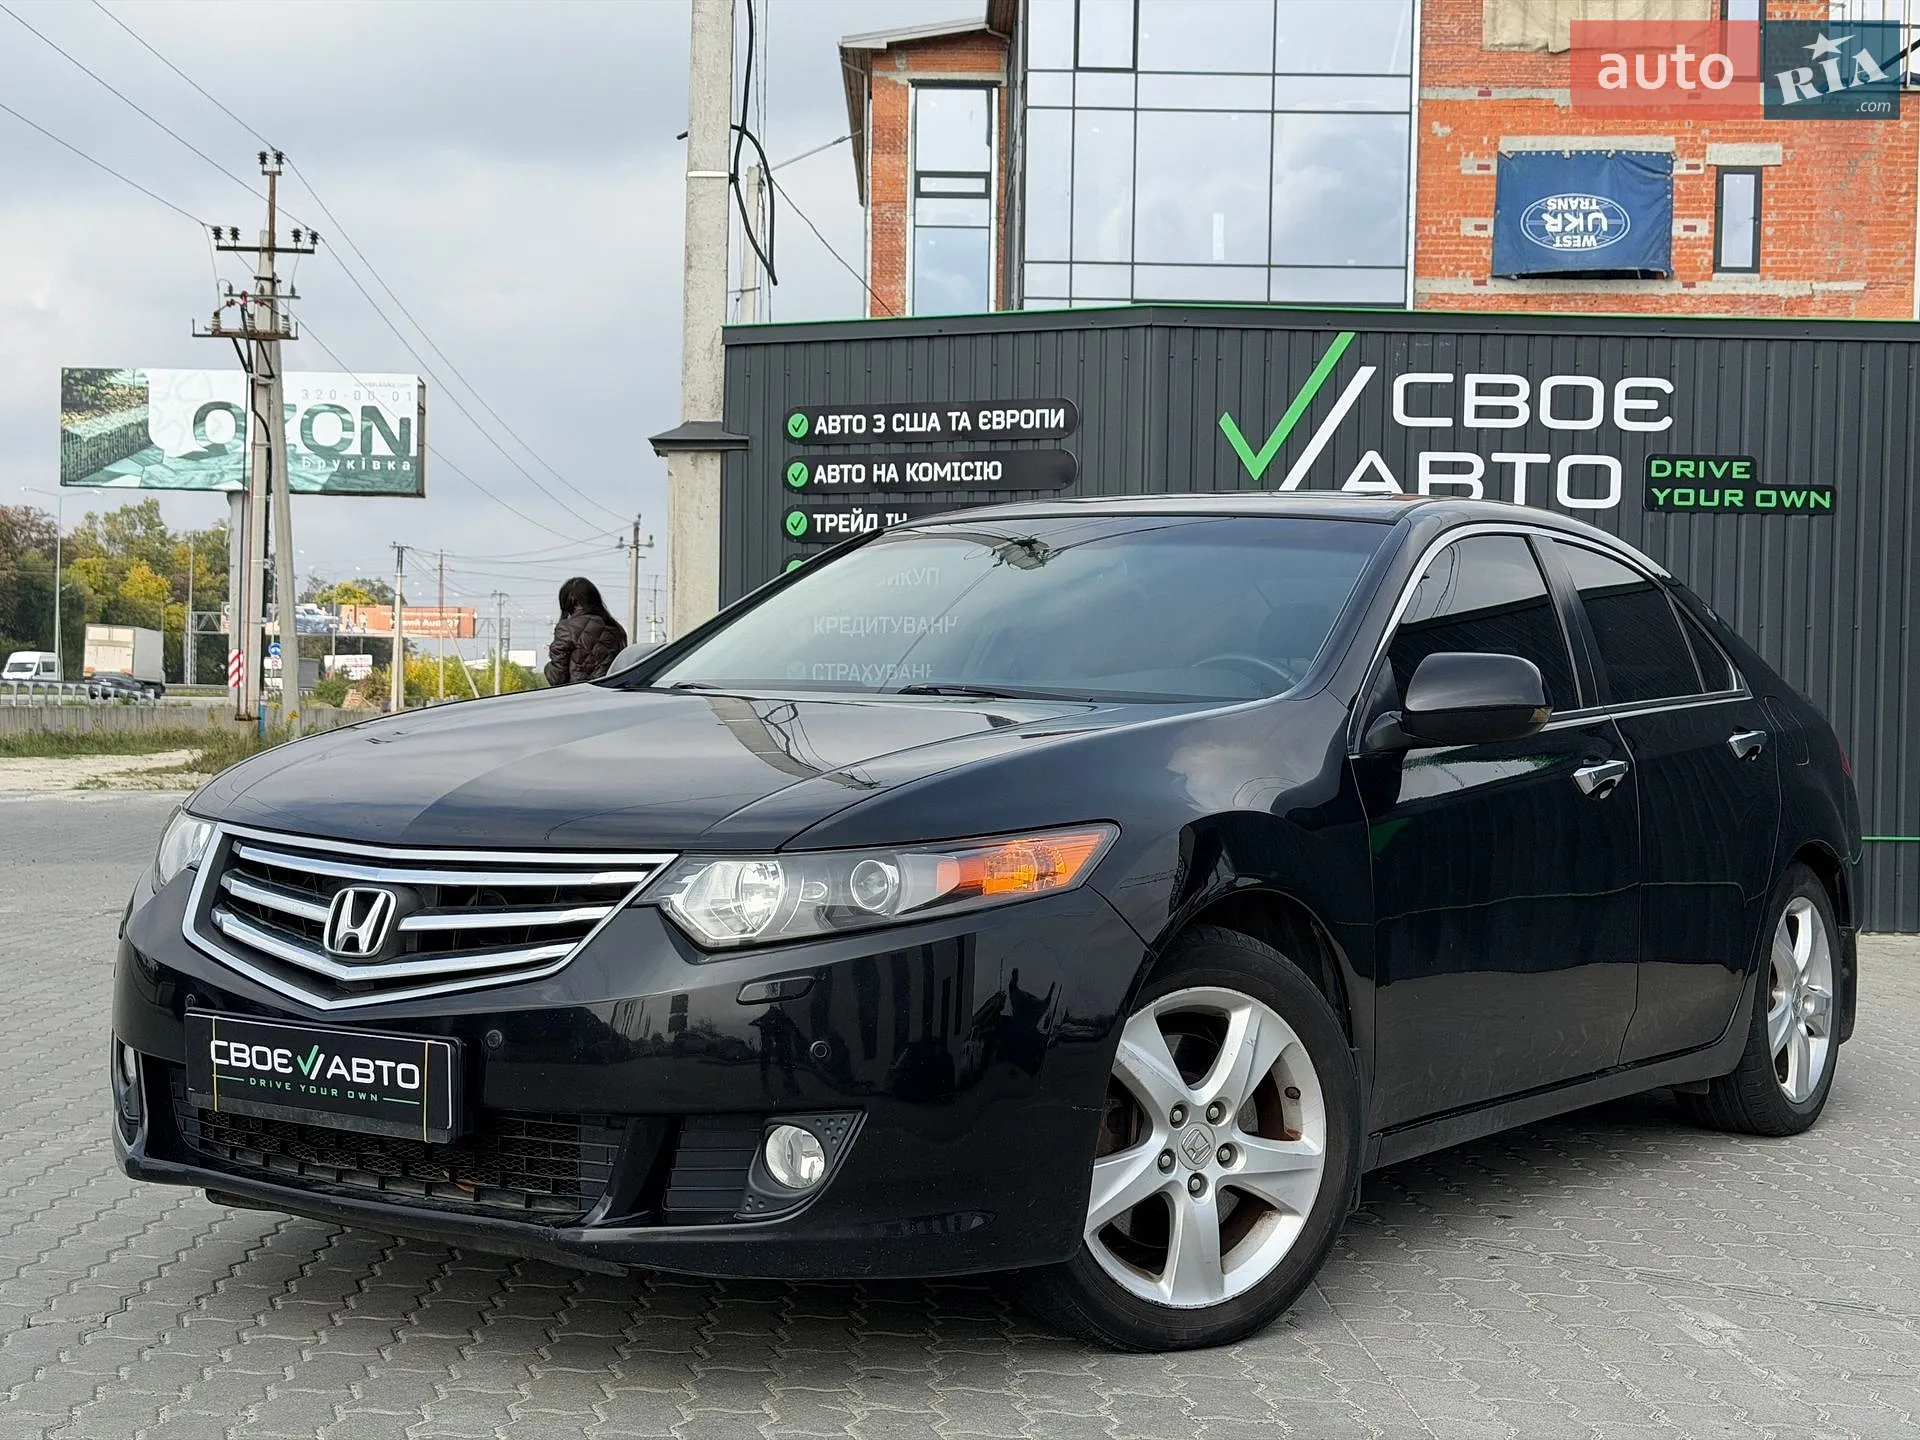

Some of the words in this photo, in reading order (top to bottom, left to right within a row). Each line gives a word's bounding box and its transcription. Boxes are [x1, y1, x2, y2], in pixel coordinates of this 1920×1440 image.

[1547, 197, 1600, 211] TRANS
[1541, 212, 1608, 232] UKR
[1553, 235, 1598, 248] WEST
[1391, 372, 1675, 432] СВОЄ
[814, 415, 867, 435] АВТО
[892, 413, 942, 433] США
[947, 412, 972, 432] ТА
[978, 408, 1066, 431] ЄВРОПИ
[814, 463, 866, 484] АВТО
[873, 462, 899, 482] НА
[906, 460, 1002, 482] КОМІСІЮ
[1341, 450, 1622, 509] АВТО
[1650, 459, 1752, 480] DRIVE
[1650, 488, 1744, 508] YOUR
[1754, 490, 1831, 509] OWN
[813, 508, 878, 533] ТРЕЙД
[210, 1040, 293, 1073] СВОЄ
[326, 1055, 420, 1090] АВТО
[249, 1077, 291, 1091] DRIVE
[299, 1083, 338, 1097] YOUR
[347, 1090, 378, 1102] OWN
